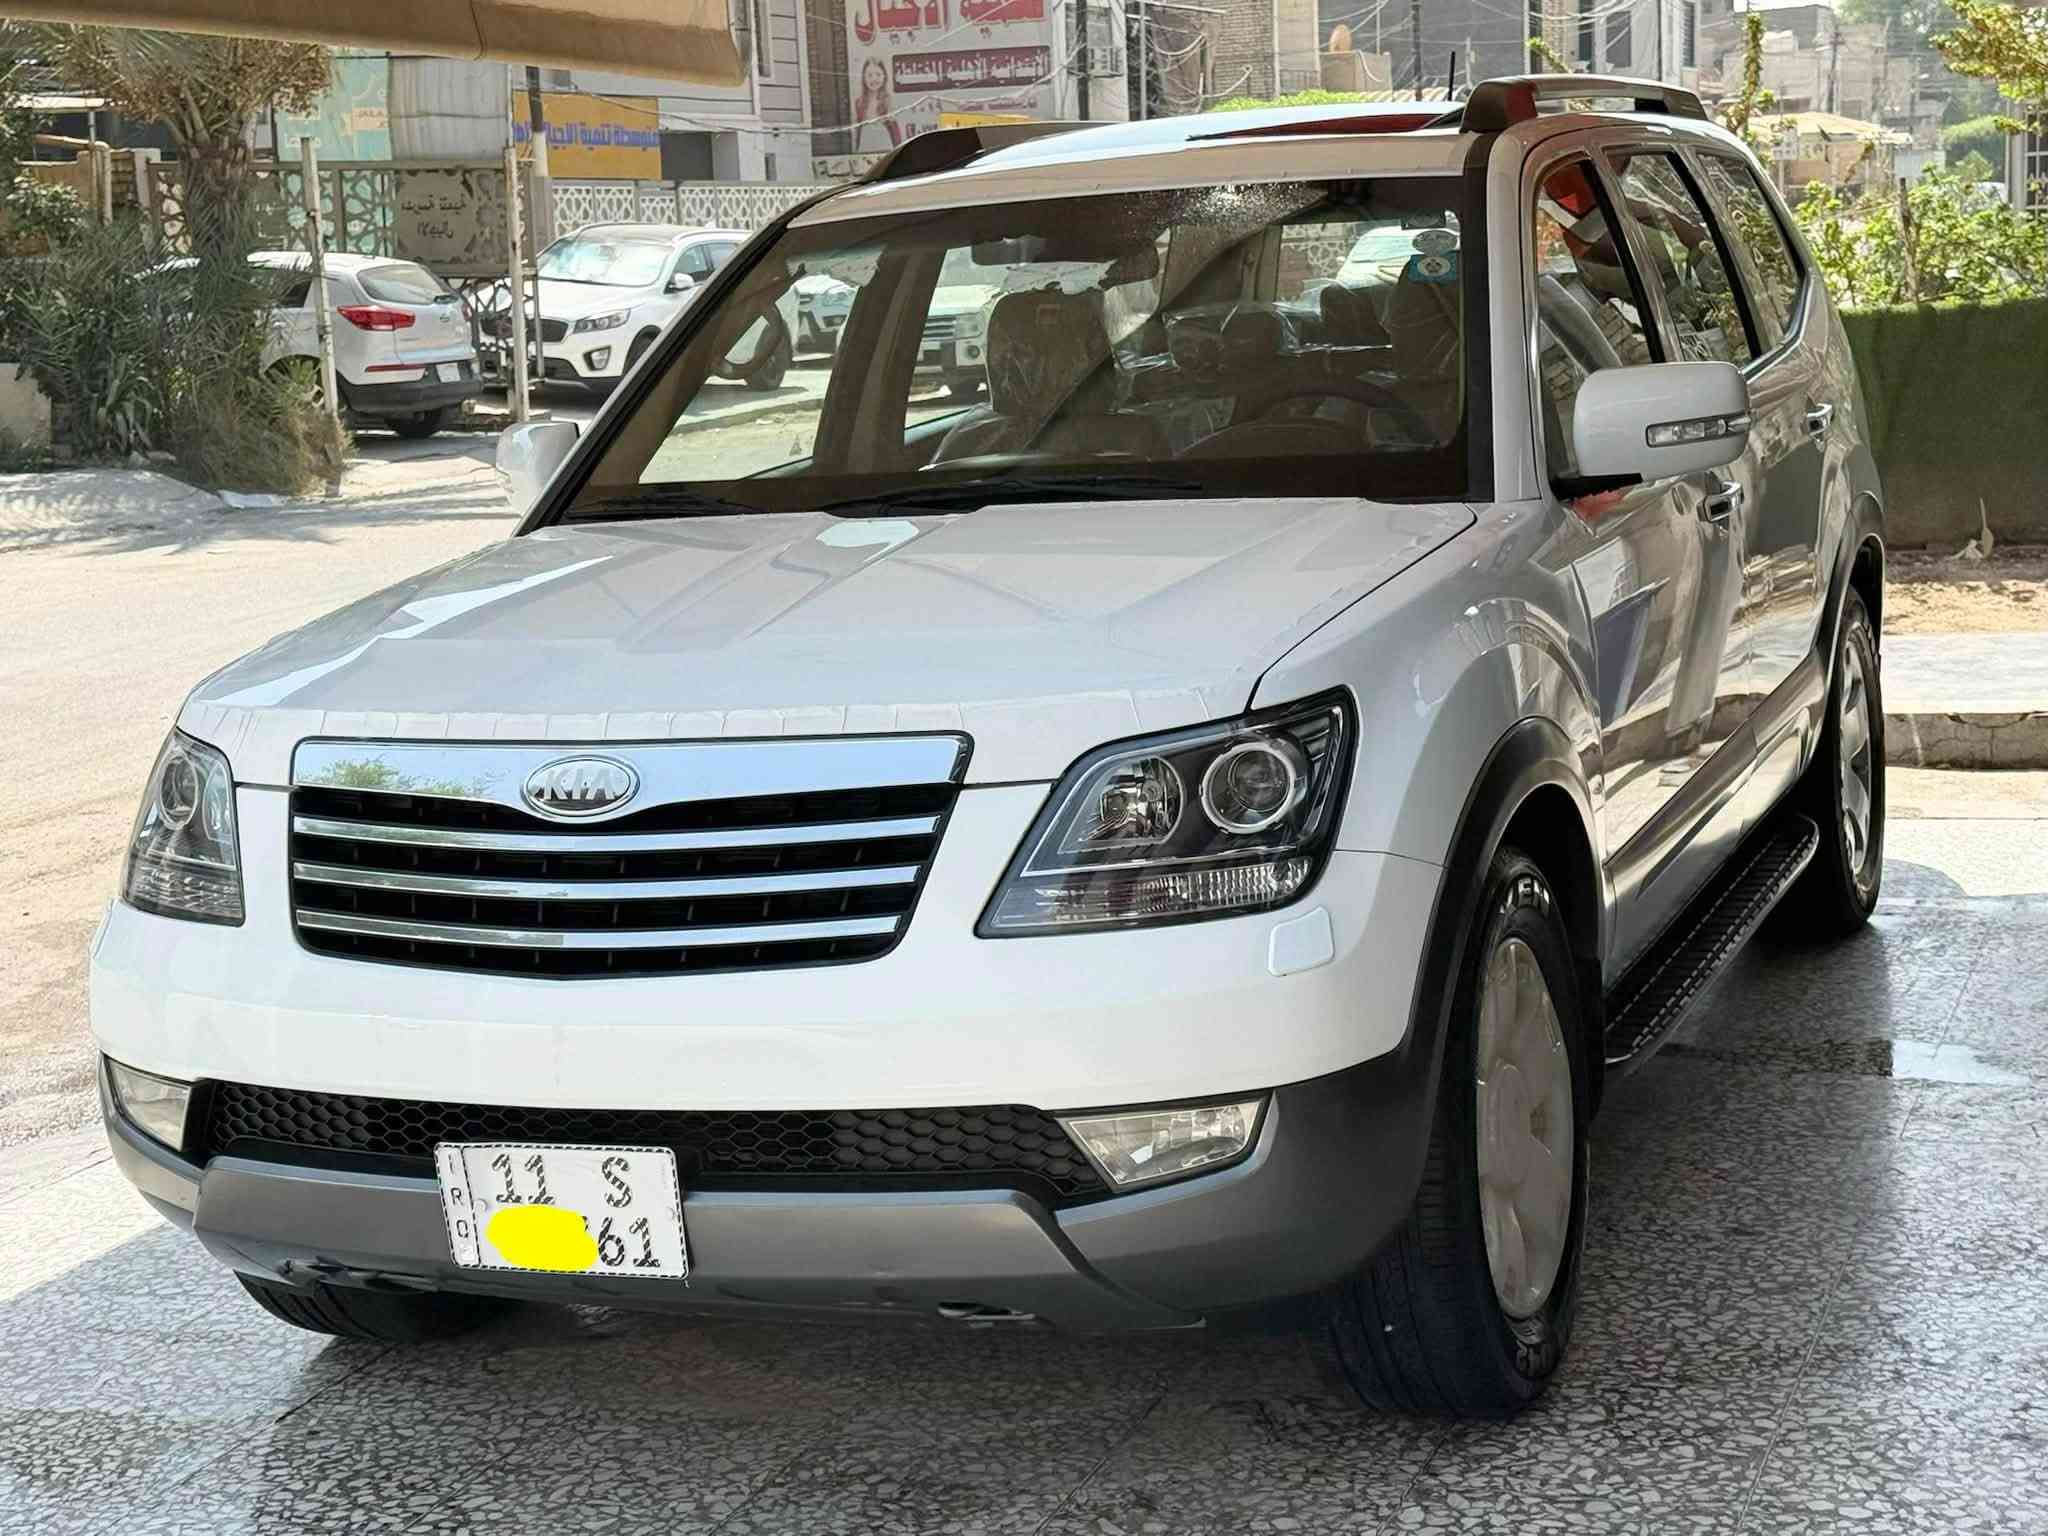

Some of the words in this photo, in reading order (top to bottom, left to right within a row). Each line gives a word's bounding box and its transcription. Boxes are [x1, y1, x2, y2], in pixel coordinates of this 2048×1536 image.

[543, 767, 623, 800] KIA
[492, 1153, 555, 1204] 11
[601, 1156, 633, 1208] S
